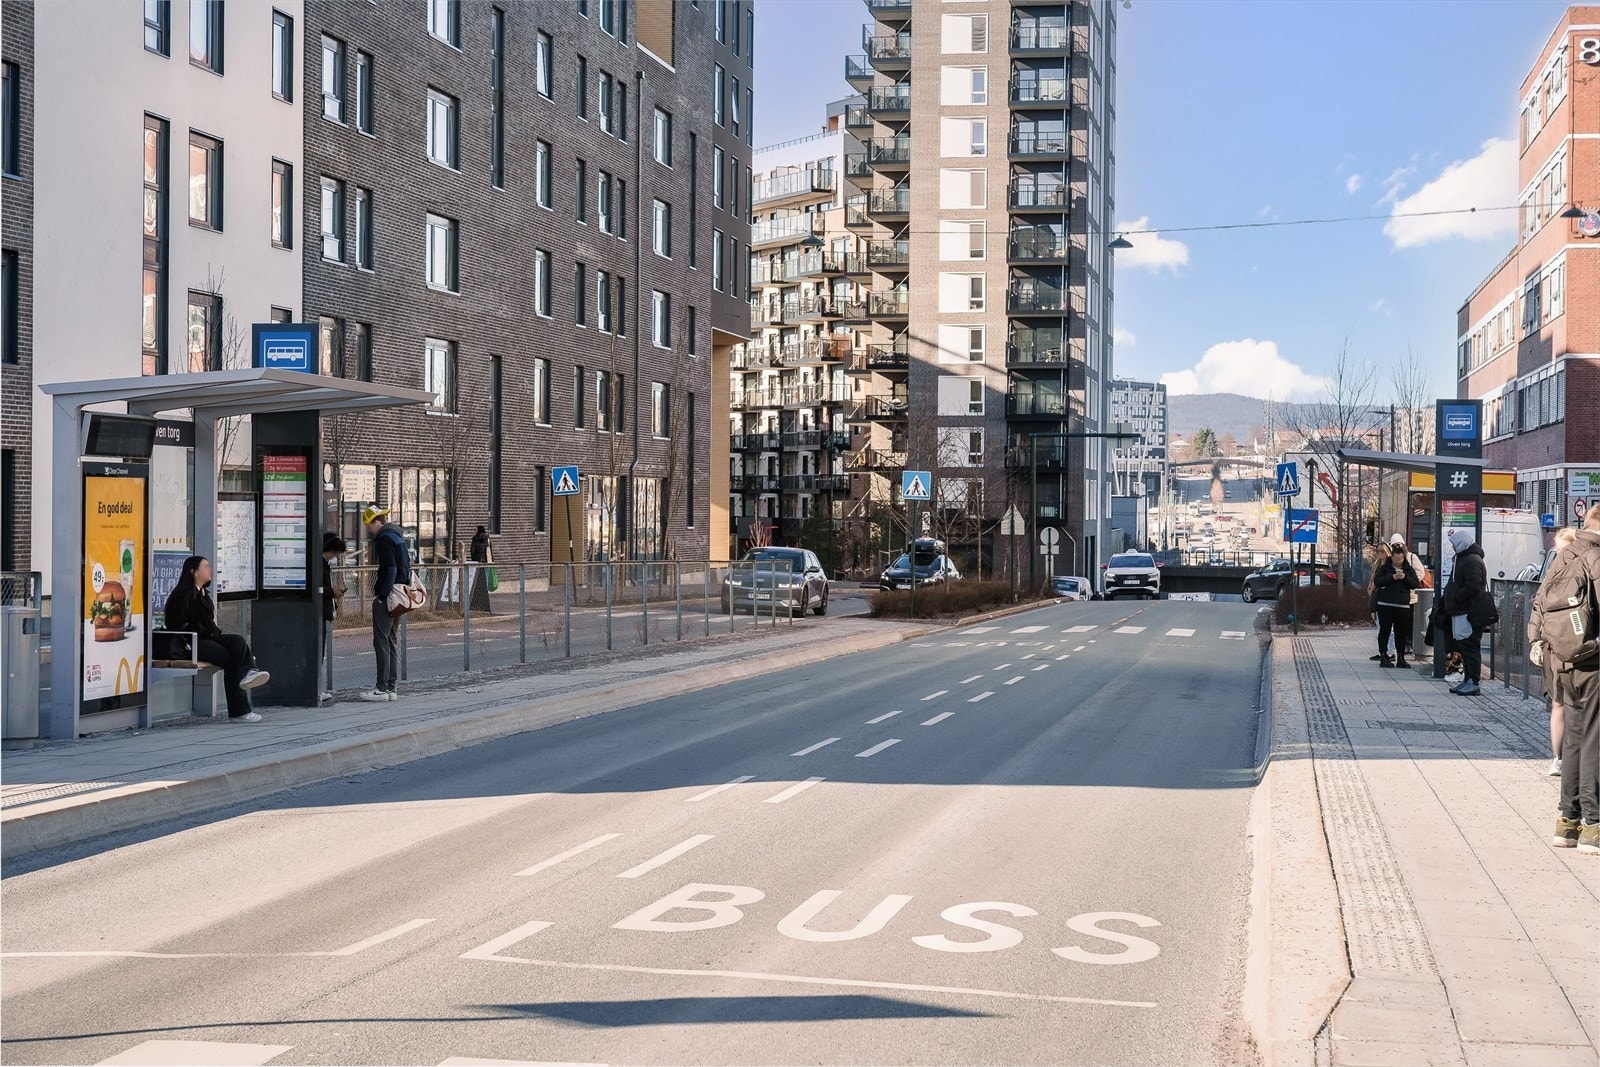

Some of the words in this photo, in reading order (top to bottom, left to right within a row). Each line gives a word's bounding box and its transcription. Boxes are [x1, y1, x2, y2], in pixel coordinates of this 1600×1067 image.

[167, 426, 180, 442] torg
[98, 501, 106, 514] En
[107, 501, 119, 518] god
[120, 501, 133, 514] deal
[161, 568, 174, 578] GIR
[609, 883, 1162, 965] BUSS
